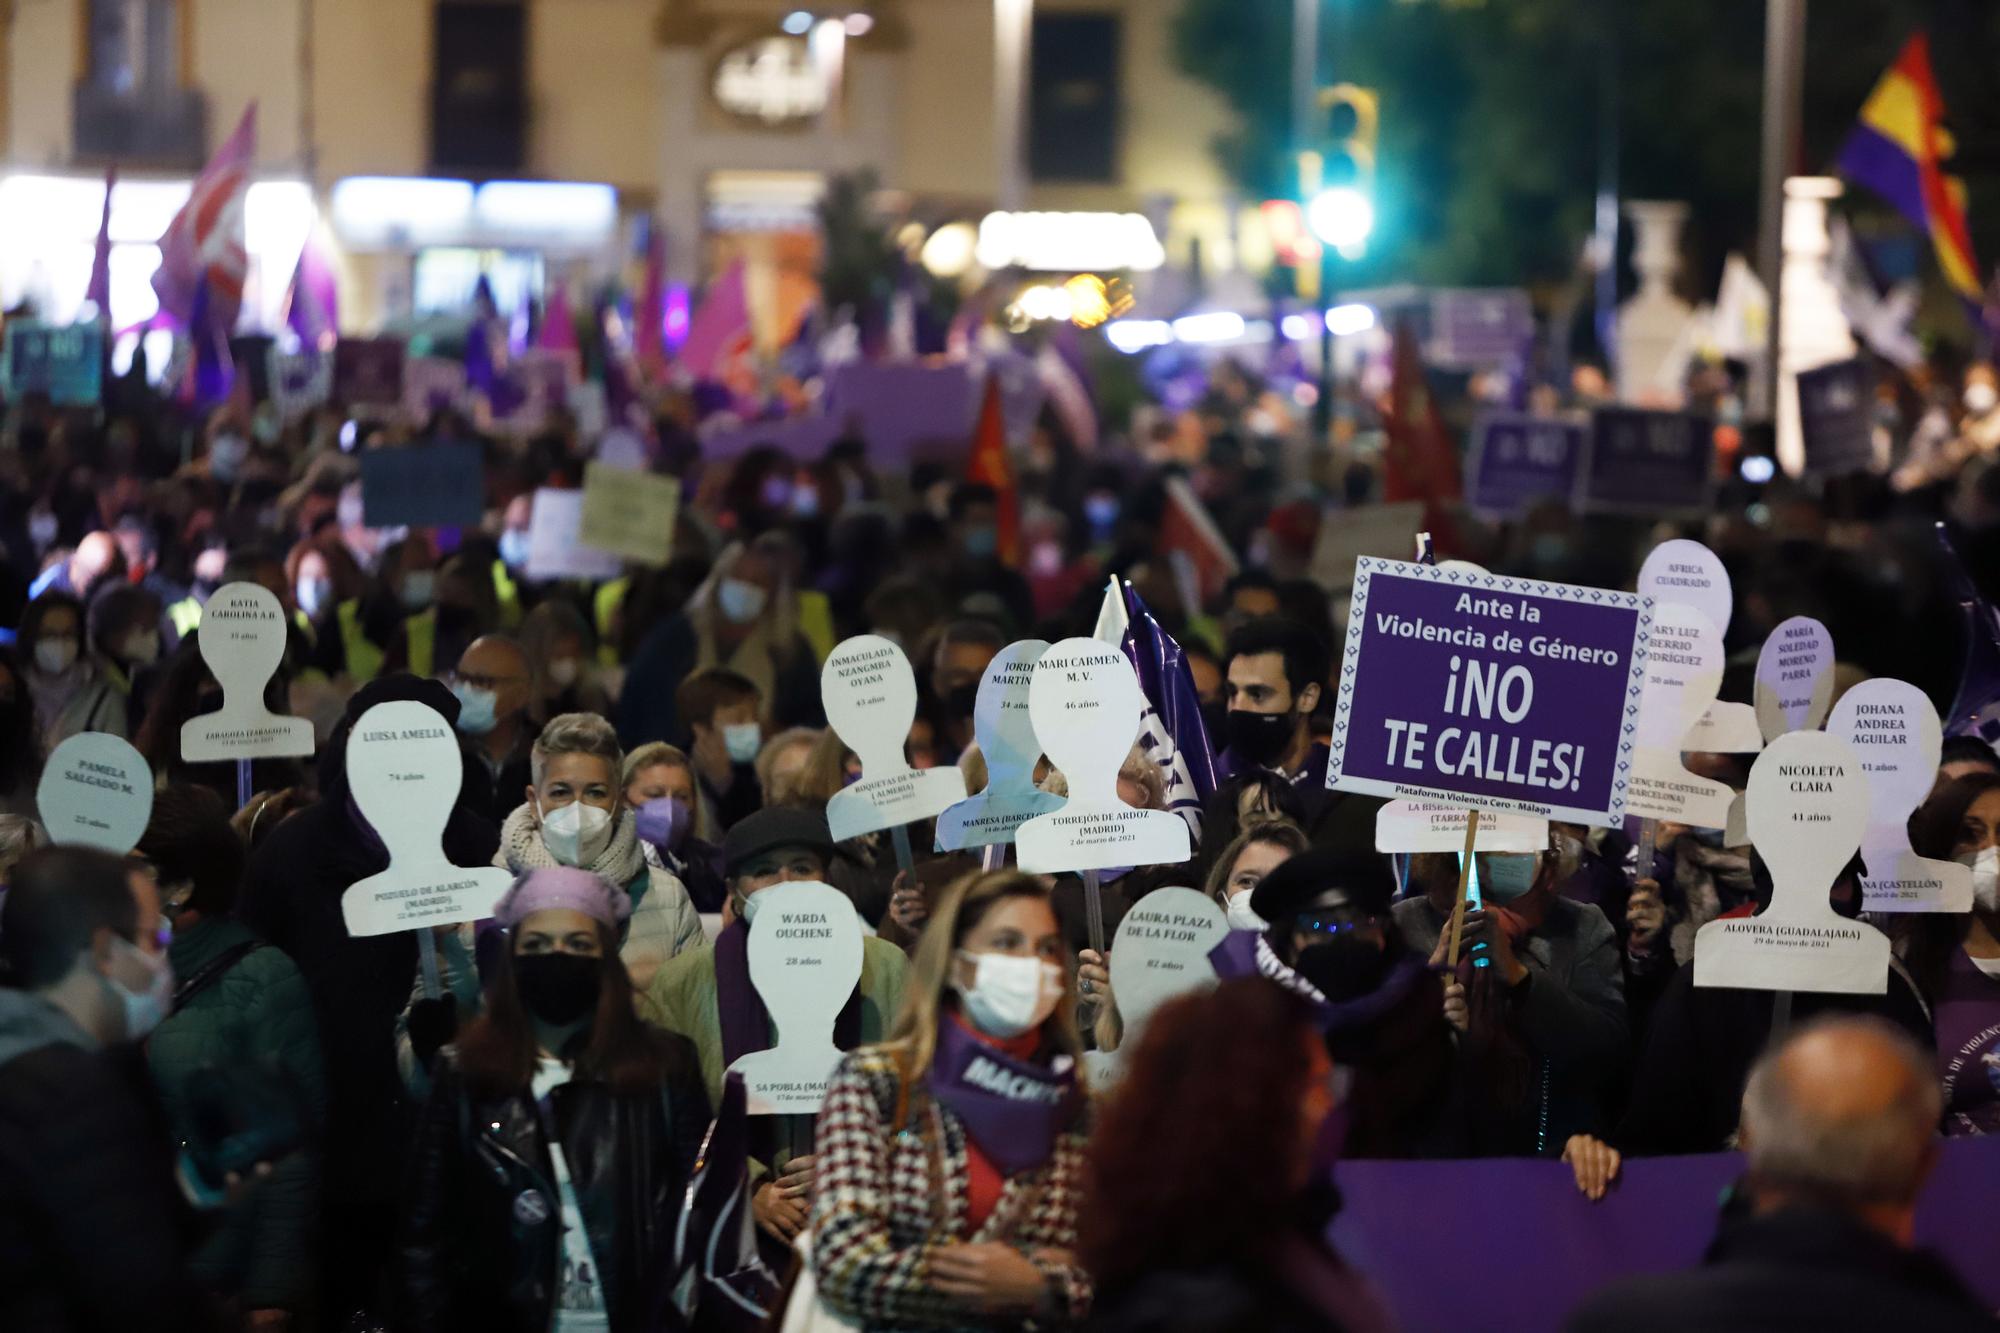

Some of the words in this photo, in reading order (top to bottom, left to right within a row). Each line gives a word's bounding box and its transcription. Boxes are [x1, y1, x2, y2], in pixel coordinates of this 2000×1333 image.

[1668, 563, 1704, 575] AFRICA
[1656, 575, 1711, 588] CUADRADO
[1455, 592, 1513, 619] Ante
[1519, 600, 1541, 623] la
[211, 610, 258, 619] CAROLINA
[1653, 625, 1675, 635] ARY
[1678, 627, 1700, 638] LUZ
[1785, 626, 1814, 638] MARÍA
[1376, 613, 1486, 649] Violencia
[1492, 629, 1522, 653] de
[1529, 636, 1619, 667] Género
[1650, 639, 1692, 651] BERRIO
[1778, 640, 1819, 654] SOLEDAD
[831, 647, 894, 667] INMACULADA
[1039, 657, 1068, 669] MARI
[1071, 655, 1120, 668] CARMEN
[1649, 651, 1702, 666] DRÍGUEZ
[1779, 654, 1816, 667] MORENO
[838, 660, 891, 677] NZANGMBA
[850, 674, 883, 687] OYANA
[992, 674, 1031, 685] MARTÍN
[1067, 672, 1080, 682] M.
[1083, 671, 1093, 681] V.
[1782, 668, 1811, 682] PARRA
[1662, 677, 1684, 686] años
[1443, 655, 1534, 724] ¡NO
[867, 696, 885, 704] años
[1000, 701, 1010, 709] 34
[1013, 701, 1029, 709] año
[1065, 701, 1076, 709] 46
[1078, 700, 1099, 709] años
[1791, 698, 1811, 707] años
[1856, 704, 1904, 716] JOHANA
[1854, 719, 1905, 730] ANDREA
[206, 731, 245, 740] ZARAGOZA
[363, 731, 397, 742] LUISA
[401, 728, 446, 740] AMELIA
[1852, 733, 1907, 744] AGUILAR
[1384, 718, 1428, 770] TE
[1434, 727, 1585, 792] CALLES!
[79, 760, 126, 778] PAMELA
[1779, 765, 1844, 776] NICOLETA
[1875, 763, 1898, 771] años
[65, 770, 119, 790] SALGADO
[855, 777, 897, 793] ROQUETAS
[898, 774, 907, 783] DE
[909, 769, 926, 779] MAR
[1630, 776, 1652, 787] CENÇ
[1654, 780, 1666, 788] DE
[1668, 782, 1717, 797] CASTELLET
[1790, 781, 1833, 792] CLARA
[1395, 785, 1445, 800] Plataforma
[1447, 793, 1488, 806] Violencia
[1490, 800, 1511, 809] Cero
[1518, 802, 1551, 815] Málaga
[1629, 787, 1686, 804] BARCELONA)
[1408, 803, 1419, 811] LA
[963, 816, 1000, 828] MANRESA
[1001, 811, 1047, 824] (BARCELO
[1052, 811, 1100, 826] TORREJÓN
[1101, 813, 1115, 822] DE
[1117, 811, 1150, 820] ARDOZ
[1431, 814, 1497, 823] (TARRANA)
[1791, 813, 1803, 821] 41
[1807, 814, 1831, 822] años
[1002, 823, 1017, 831] abril
[1080, 824, 1125, 836] (MADRID)
[375, 888, 417, 901] POZUELO
[420, 886, 432, 895] DE
[435, 879, 479, 892] ALARCÓN
[1863, 881, 1877, 889] NA
[1879, 879, 1943, 890] (CASTELLÓN)
[405, 896, 453, 910] (MADRID)
[782, 913, 827, 923] WARDA
[1130, 911, 1170, 924] LAURA
[1173, 915, 1213, 929] PLAZA
[776, 928, 833, 938] OUCHENE
[1127, 926, 1143, 937] DE
[1145, 928, 1160, 938] LA
[1164, 930, 1196, 942] FLOR
[1724, 923, 1773, 934] ALOVERA
[1776, 926, 1861, 940] (GUADALAJARA)
[1754, 936, 1764, 944] 29
[1776, 939, 1798, 947] mayo
[1811, 940, 1830, 948] 2021
[786, 957, 798, 966] 28
[800, 957, 822, 966] años
[1161, 962, 1184, 970] años
[1960, 1024, 2000, 1055] VIOLENC
[756, 1083, 768, 1092] SA
[770, 1082, 802, 1092] POBLA
